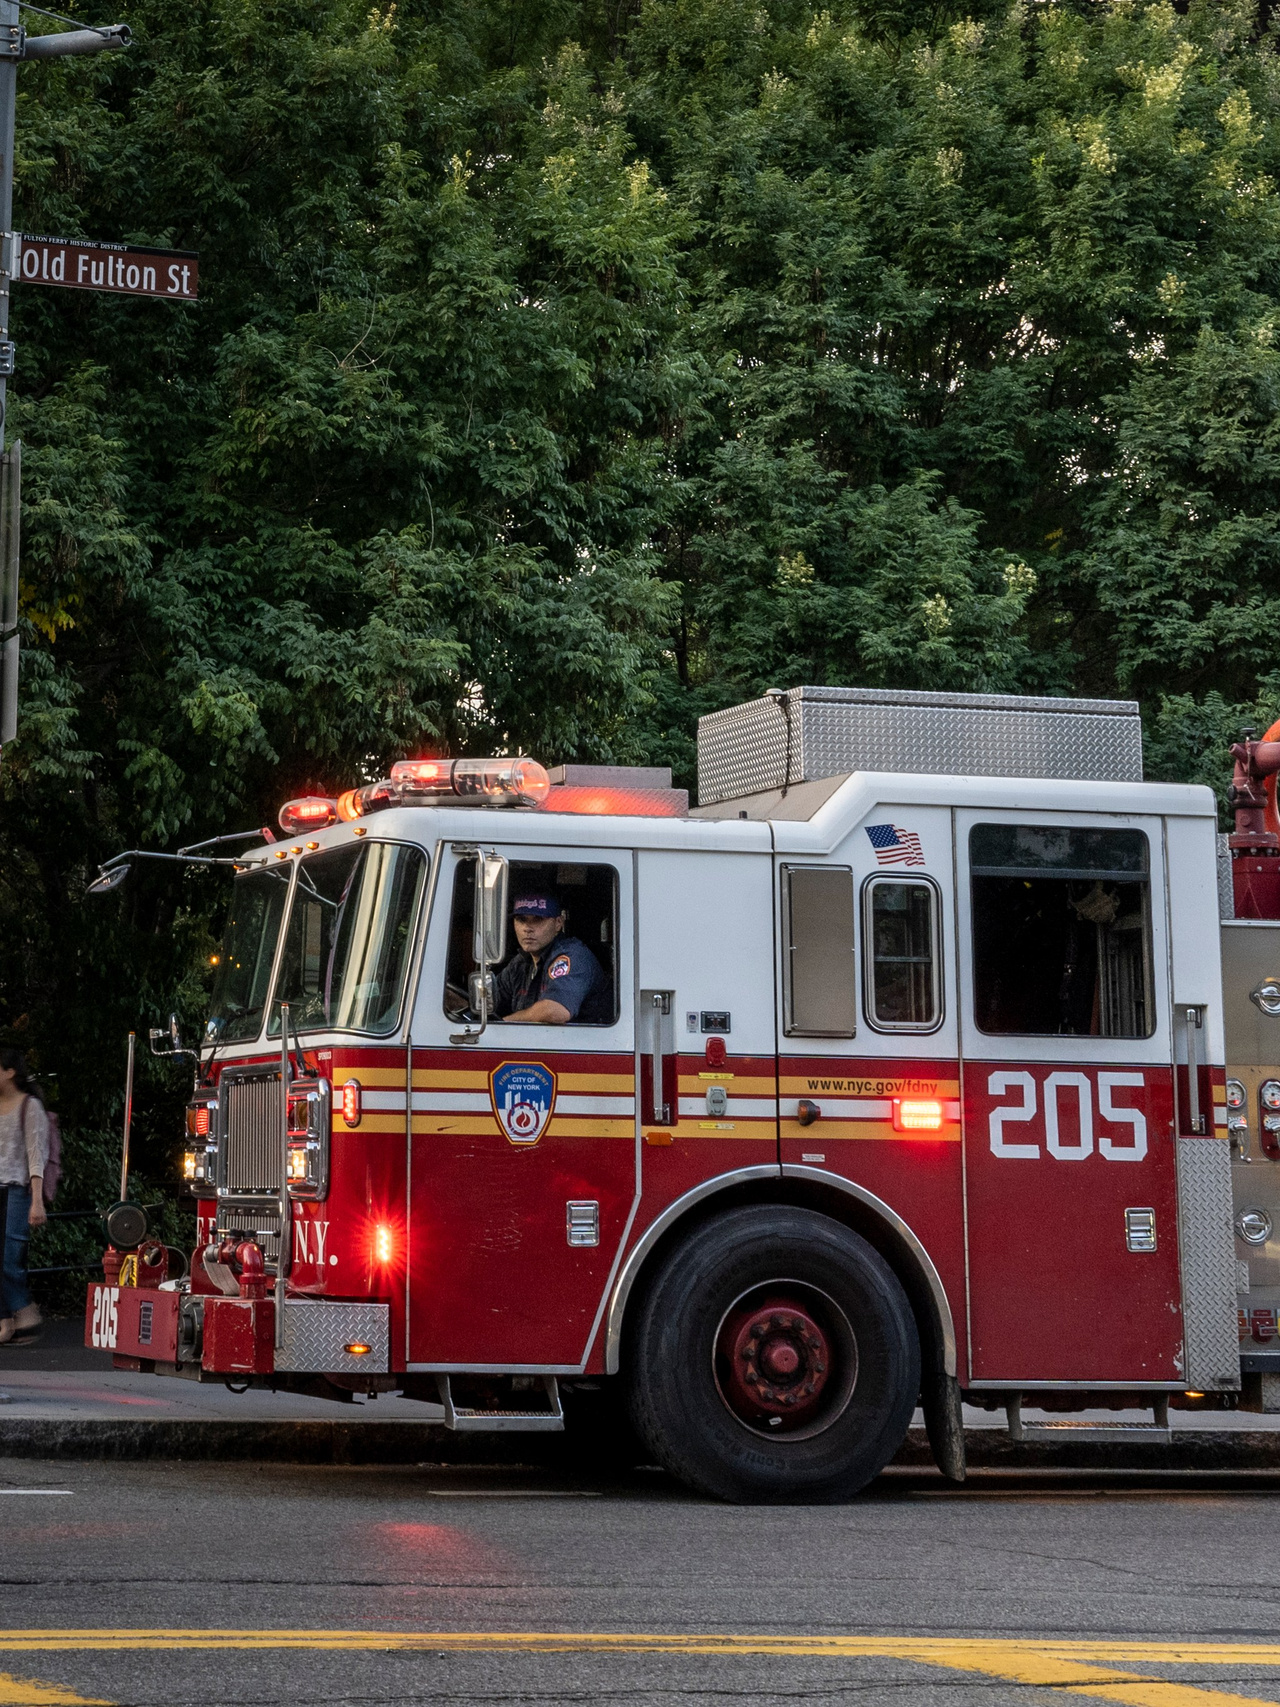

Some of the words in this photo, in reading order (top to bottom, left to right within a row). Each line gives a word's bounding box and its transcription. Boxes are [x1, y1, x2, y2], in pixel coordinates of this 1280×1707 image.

[23, 234, 48, 243] FULTON
[48, 237, 68, 246] FERRY
[69, 240, 98, 249] HISTORIC
[100, 243, 128, 252] DISTRICT
[22, 248, 65, 281] Old
[77, 254, 156, 291] Fulton
[167, 264, 191, 295] St
[498, 1072, 511, 1086] FIRE
[510, 1068, 549, 1086] DEPARTMENT
[807, 1079, 938, 1096] www.nyc.gov/fdny
[988, 1070, 1148, 1162] 205
[294, 1220, 338, 1266] N.Y.
[92, 1286, 120, 1349] 205
